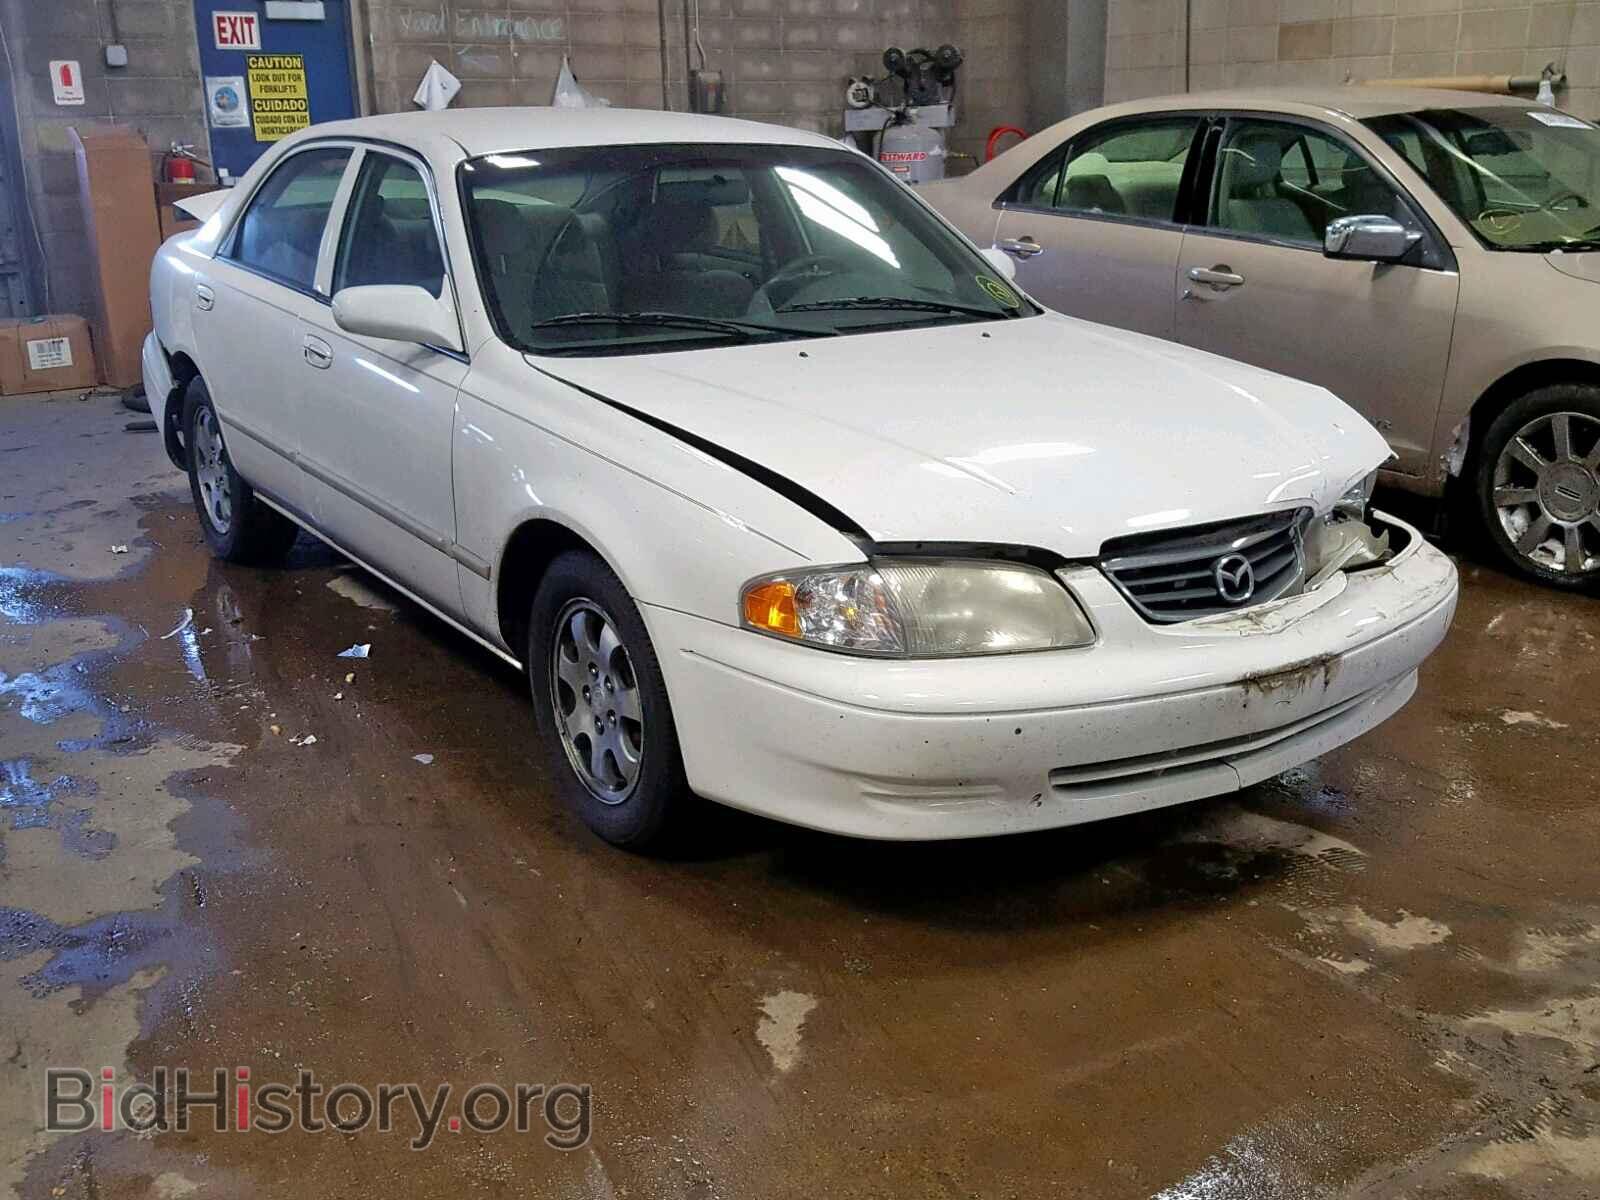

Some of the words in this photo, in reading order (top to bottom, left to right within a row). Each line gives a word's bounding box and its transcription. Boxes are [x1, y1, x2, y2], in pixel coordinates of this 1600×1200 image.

[216, 15, 255, 45] EXIT
[248, 57, 302, 69] CAUTION
[251, 74, 270, 82] LOOK
[272, 74, 286, 82] OUT
[288, 73, 302, 82] FOR
[259, 85, 298, 93] FORKLIFTS
[254, 100, 306, 111] CUIDADO
[255, 115, 282, 124] CUIDADO
[283, 115, 296, 124] CON
[297, 114, 308, 123] LOS
